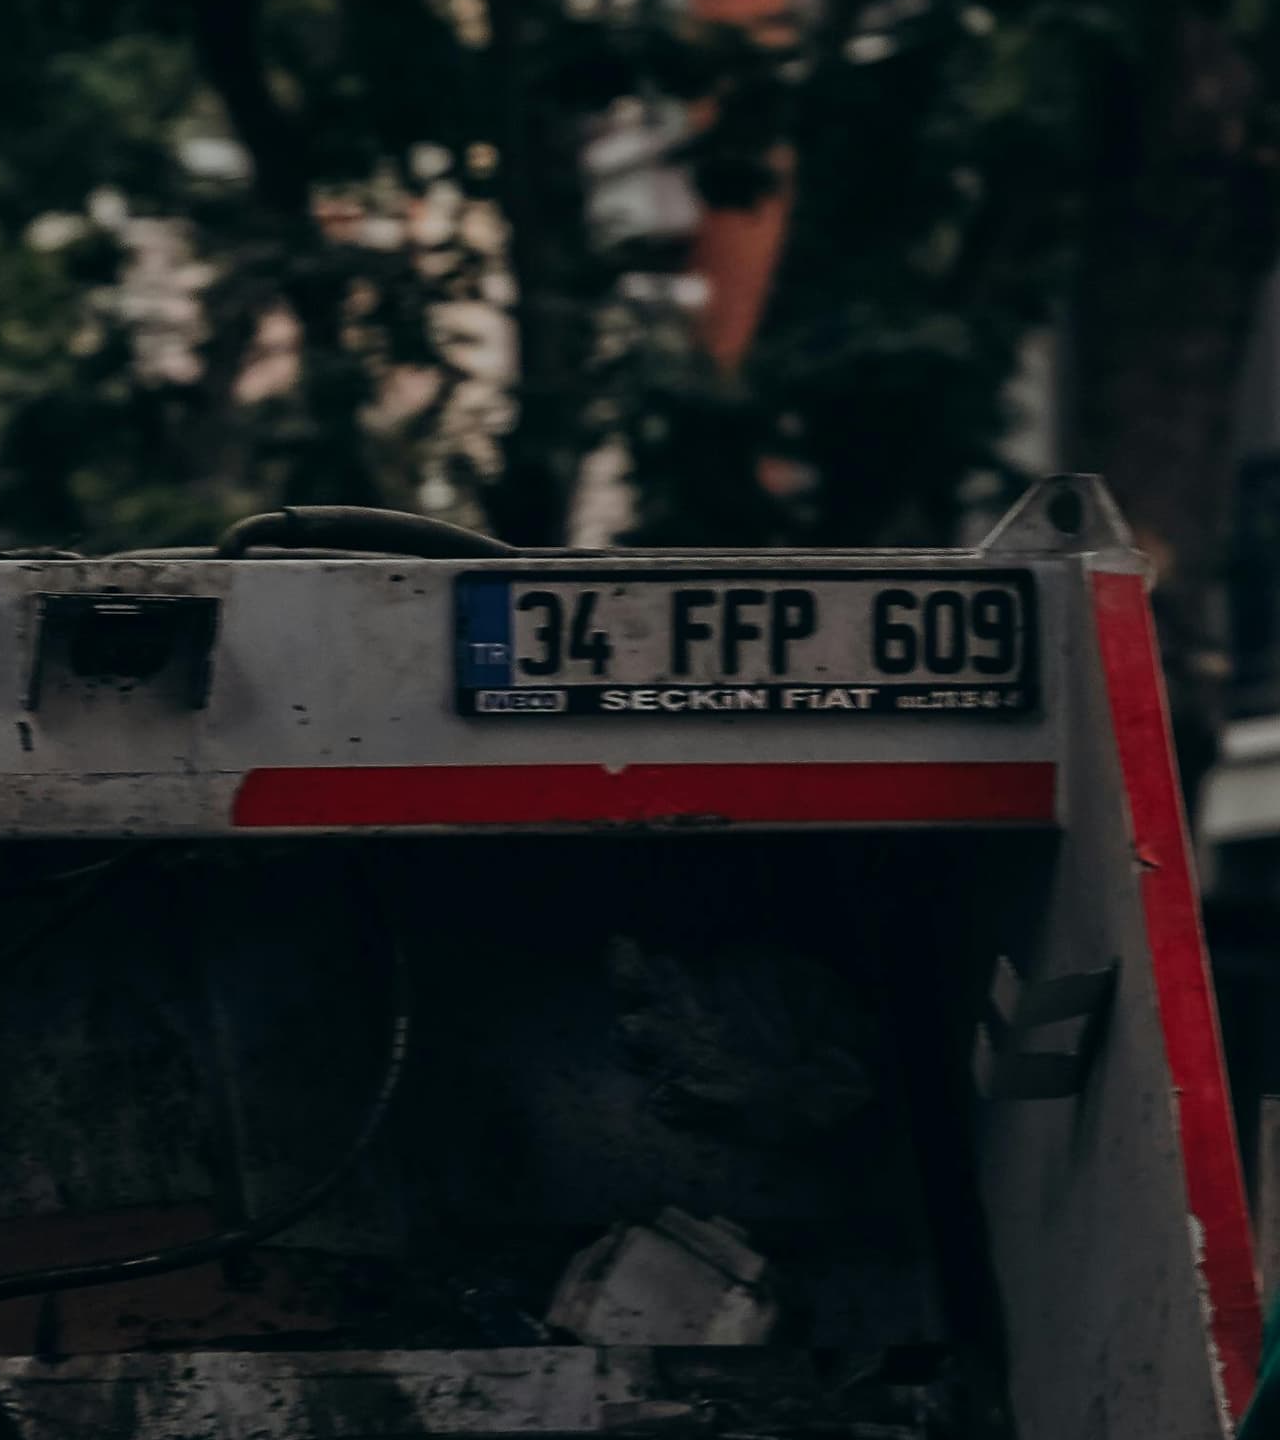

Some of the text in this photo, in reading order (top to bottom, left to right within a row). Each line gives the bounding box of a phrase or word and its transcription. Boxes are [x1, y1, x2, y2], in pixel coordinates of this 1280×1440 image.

[468, 643, 508, 664] TR
[517, 590, 1014, 675] 34 FFP 609
